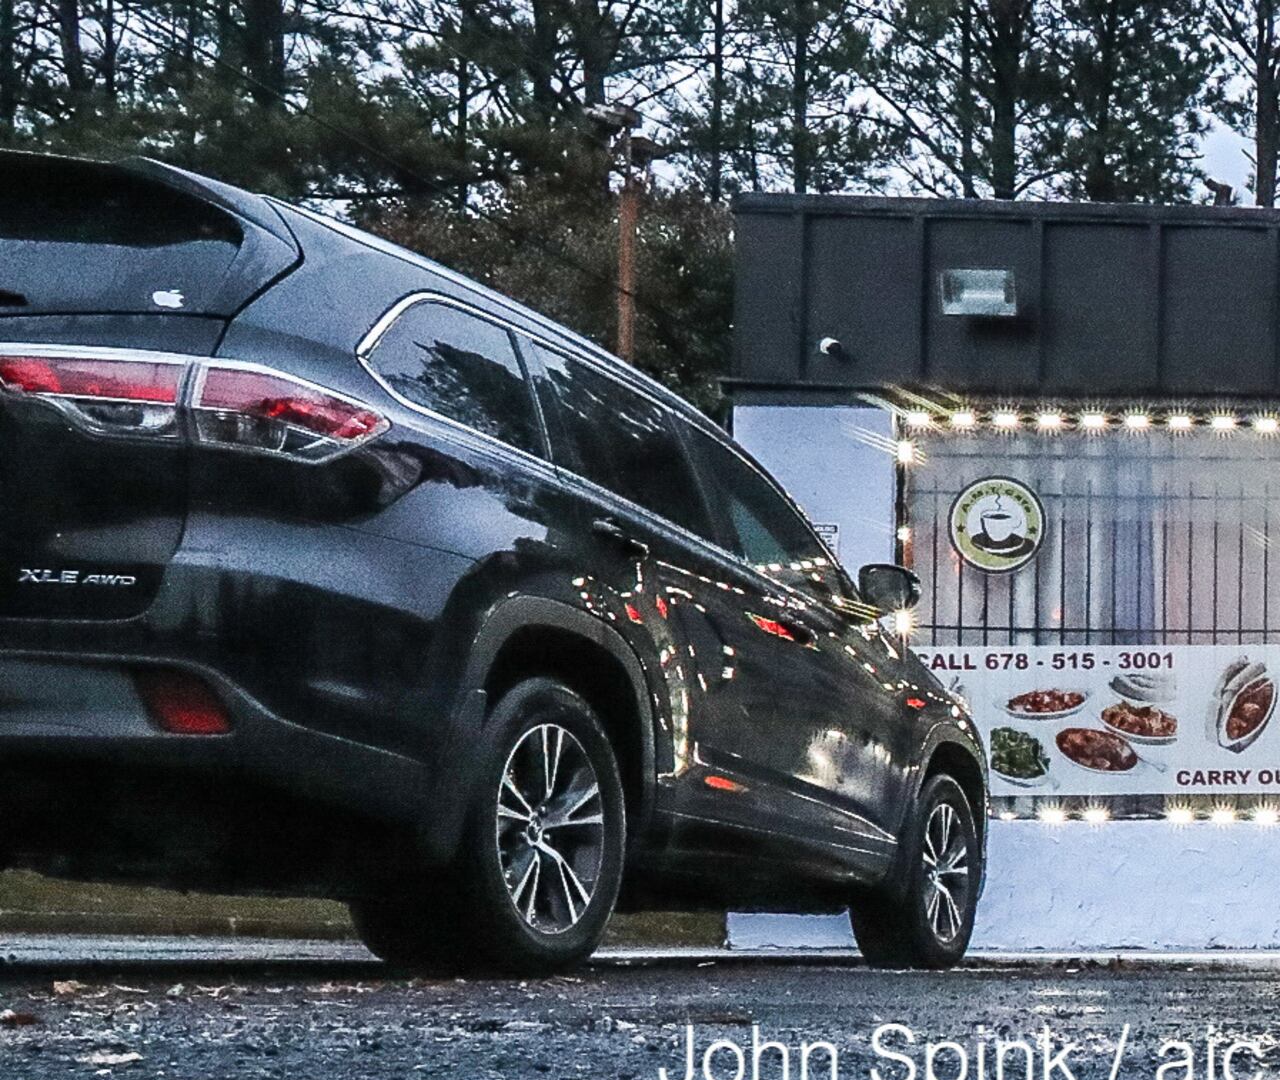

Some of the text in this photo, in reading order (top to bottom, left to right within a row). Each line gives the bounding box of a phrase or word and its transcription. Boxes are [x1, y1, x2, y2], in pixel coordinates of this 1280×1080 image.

[18, 568, 137, 586] XLE AWD
[985, 653, 1029, 670] 678
[1052, 653, 1095, 670] 515
[1118, 653, 1174, 670] 3001
[1176, 770, 1251, 785] CARRY
